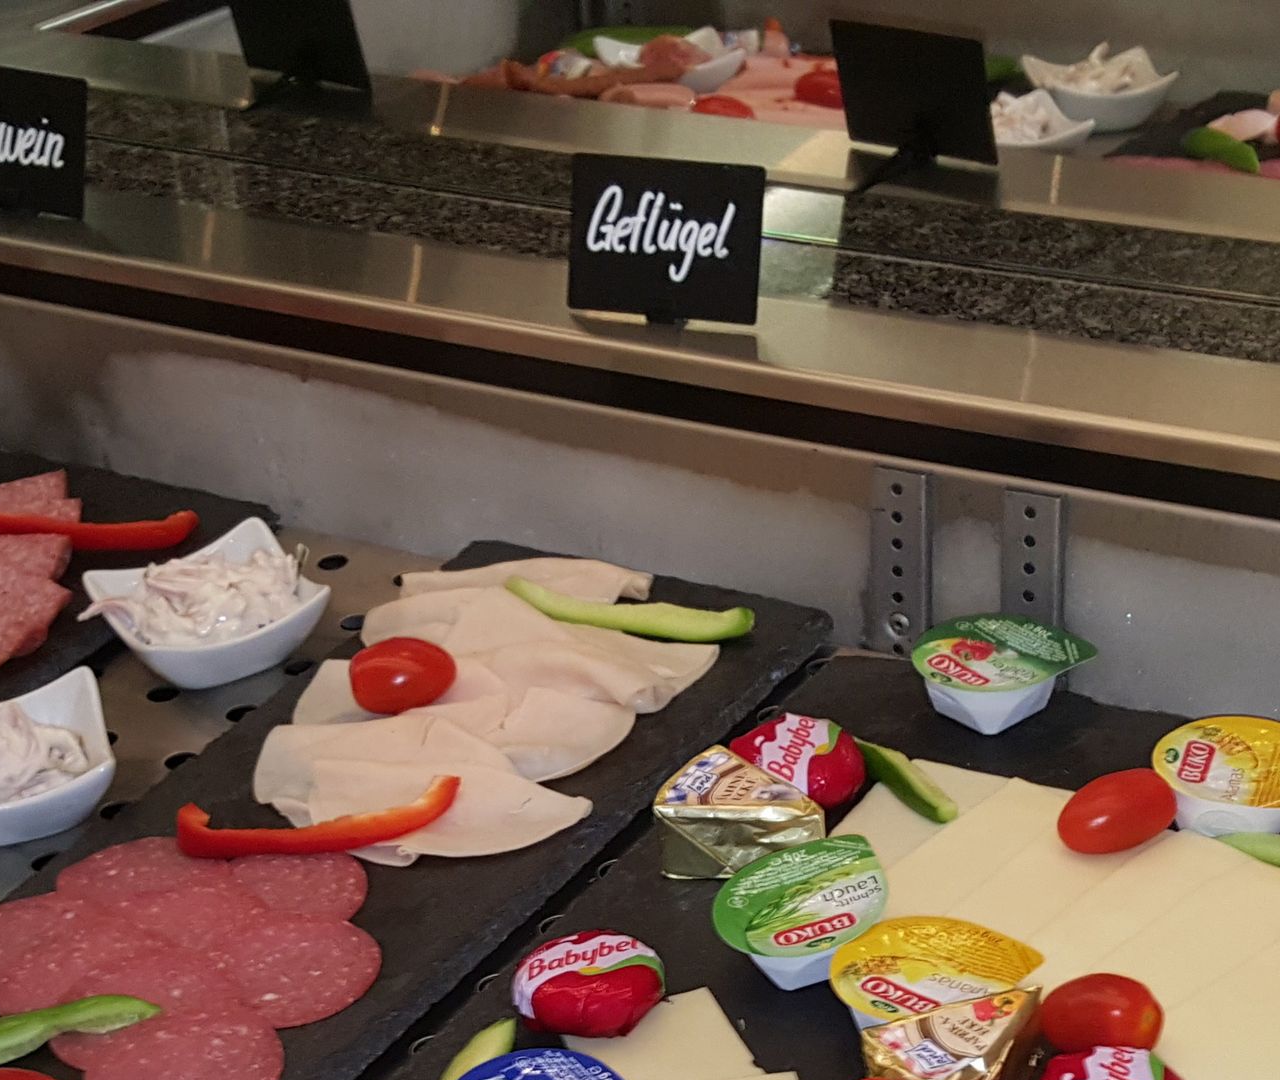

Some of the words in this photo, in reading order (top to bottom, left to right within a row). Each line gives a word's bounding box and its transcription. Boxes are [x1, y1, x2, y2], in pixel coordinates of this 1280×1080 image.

[586, 184, 736, 283] Geflügel
[931, 655, 988, 686] BUKO
[1180, 742, 1211, 782] BUKO
[822, 874, 879, 903] Lauch
[777, 915, 853, 945] BUKO
[526, 938, 640, 981] Babybel
[864, 978, 939, 1014] BUKO
